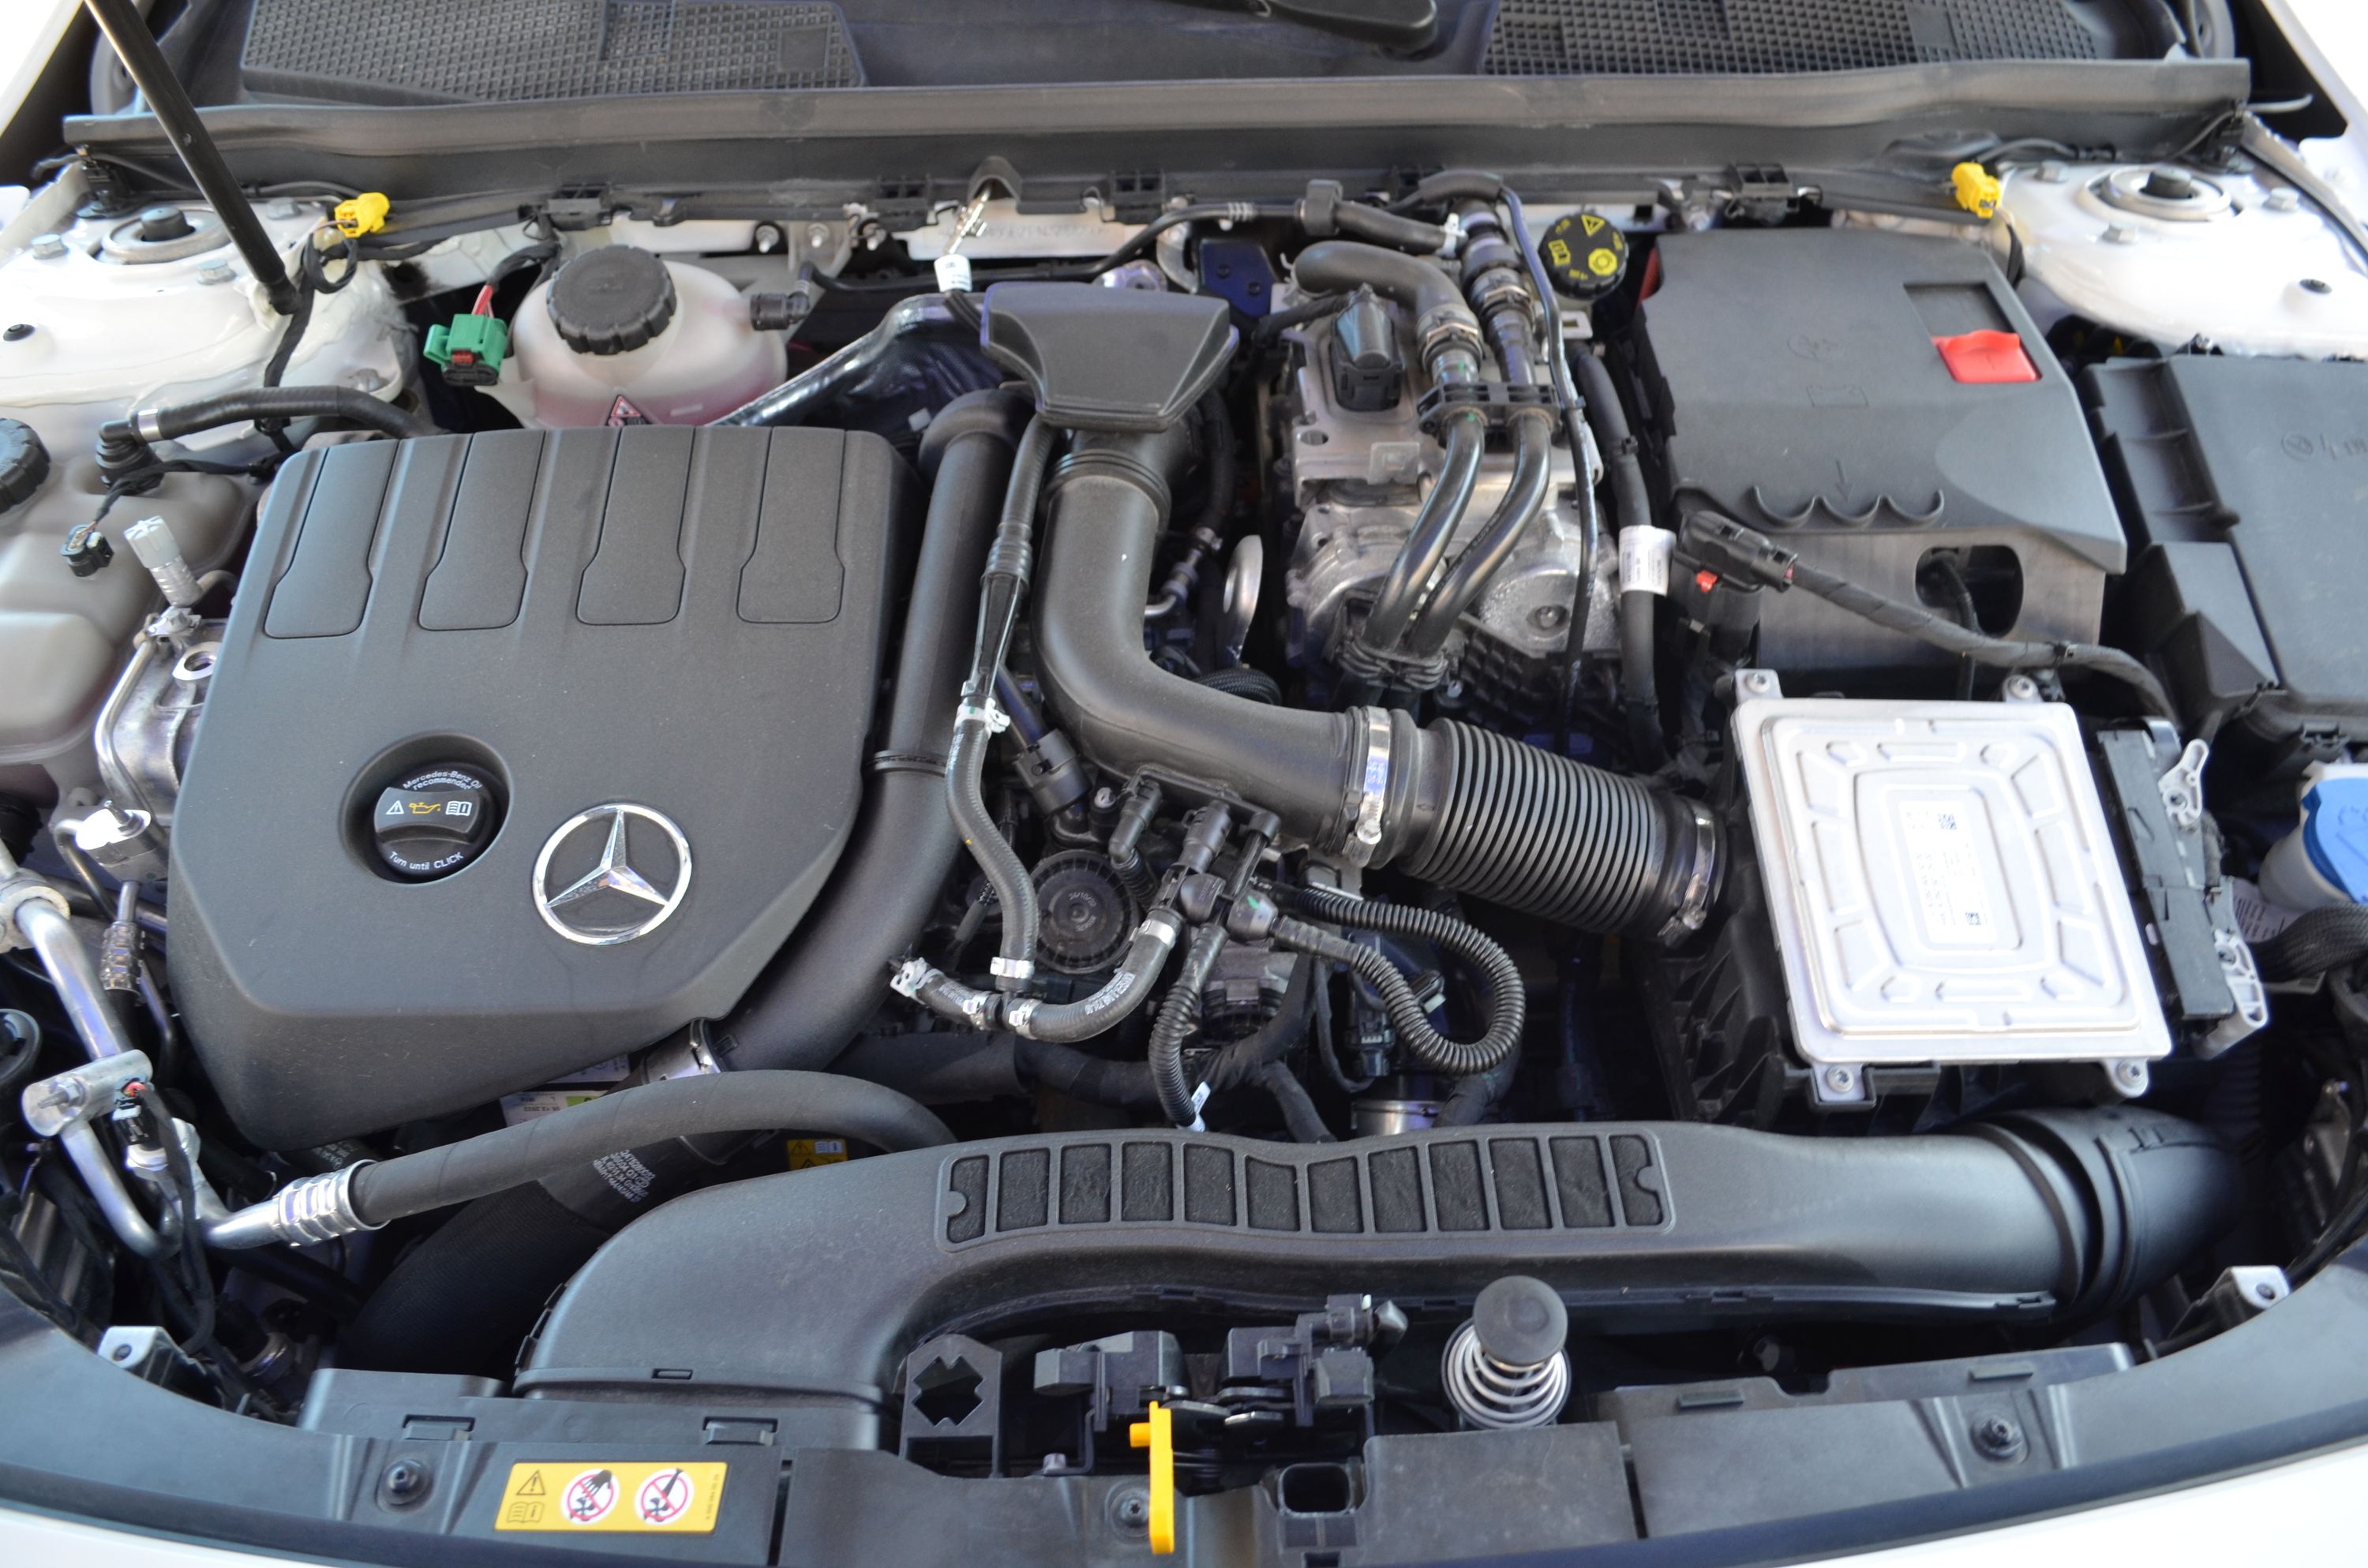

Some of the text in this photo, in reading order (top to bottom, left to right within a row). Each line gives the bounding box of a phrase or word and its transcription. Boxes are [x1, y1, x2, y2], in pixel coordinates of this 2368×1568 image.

[403, 770, 472, 789] Mercedes-Benz
[389, 851, 464, 870] Turn until CLICK
